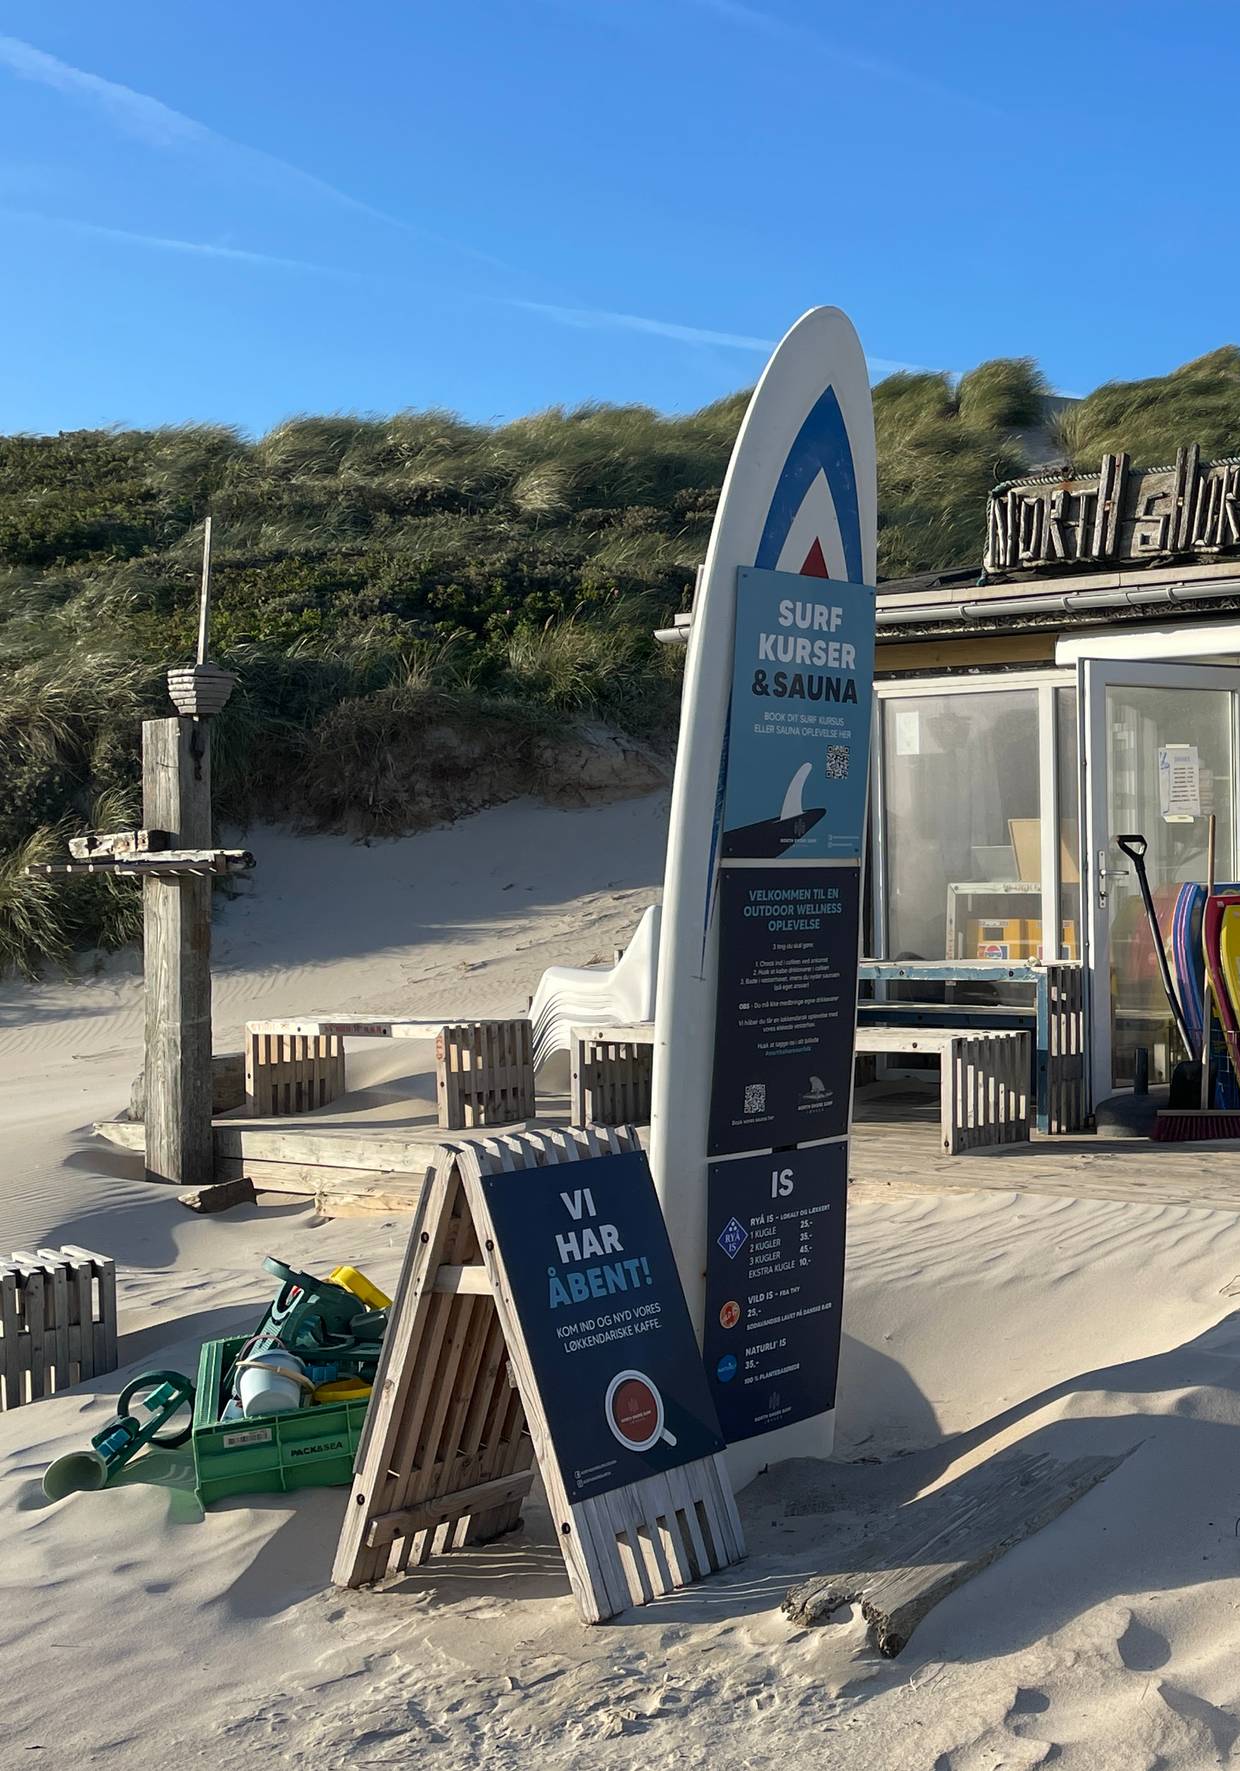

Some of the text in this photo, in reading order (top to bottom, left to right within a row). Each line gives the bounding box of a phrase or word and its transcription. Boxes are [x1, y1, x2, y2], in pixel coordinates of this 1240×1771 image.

[986, 452, 1130, 568] NORTH
[778, 600, 843, 632] SURF
[758, 633, 856, 670] KURSER
[764, 711, 845, 727] BOOK DIT SURF KURSUS
[754, 723, 852, 739] ELLER SAUNA OPLEVELSE HER
[749, 888, 839, 901] VELKOMMEN TIL EN
[743, 903, 842, 917] OUTDOOR WELLNESS
[768, 918, 821, 931] OPLEVELSE
[771, 1168, 794, 1198] IS
[559, 1187, 597, 1221] VI
[750, 1213, 765, 1227] RYÅ
[767, 1213, 774, 1223] IS
[780, 1210, 799, 1221] LOKALT
[725, 1229, 740, 1244] RYÅ
[750, 1231, 754, 1240] 1
[755, 1226, 777, 1239] KUGLE
[555, 1224, 624, 1264] HAR
[729, 1242, 736, 1252] IS
[749, 1243, 755, 1253] 2
[755, 1238, 781, 1251] KUGLER
[749, 1256, 754, 1266] 3
[754, 1251, 781, 1264] KUGLER
[748, 1266, 774, 1279] EKSTRA
[774, 1260, 796, 1272] KUGLE
[547, 1256, 653, 1309] ÅBENT!
[747, 1292, 765, 1305] VILD
[766, 1291, 774, 1301] IS
[779, 1289, 790, 1297] FRA
[556, 1302, 662, 1339] KOM IND OG NYD VORES
[563, 1318, 662, 1353] LØKKENDARISKE KAFFE.
[779, 1337, 787, 1348] IS
[290, 1441, 343, 1457] PACK&SEA
